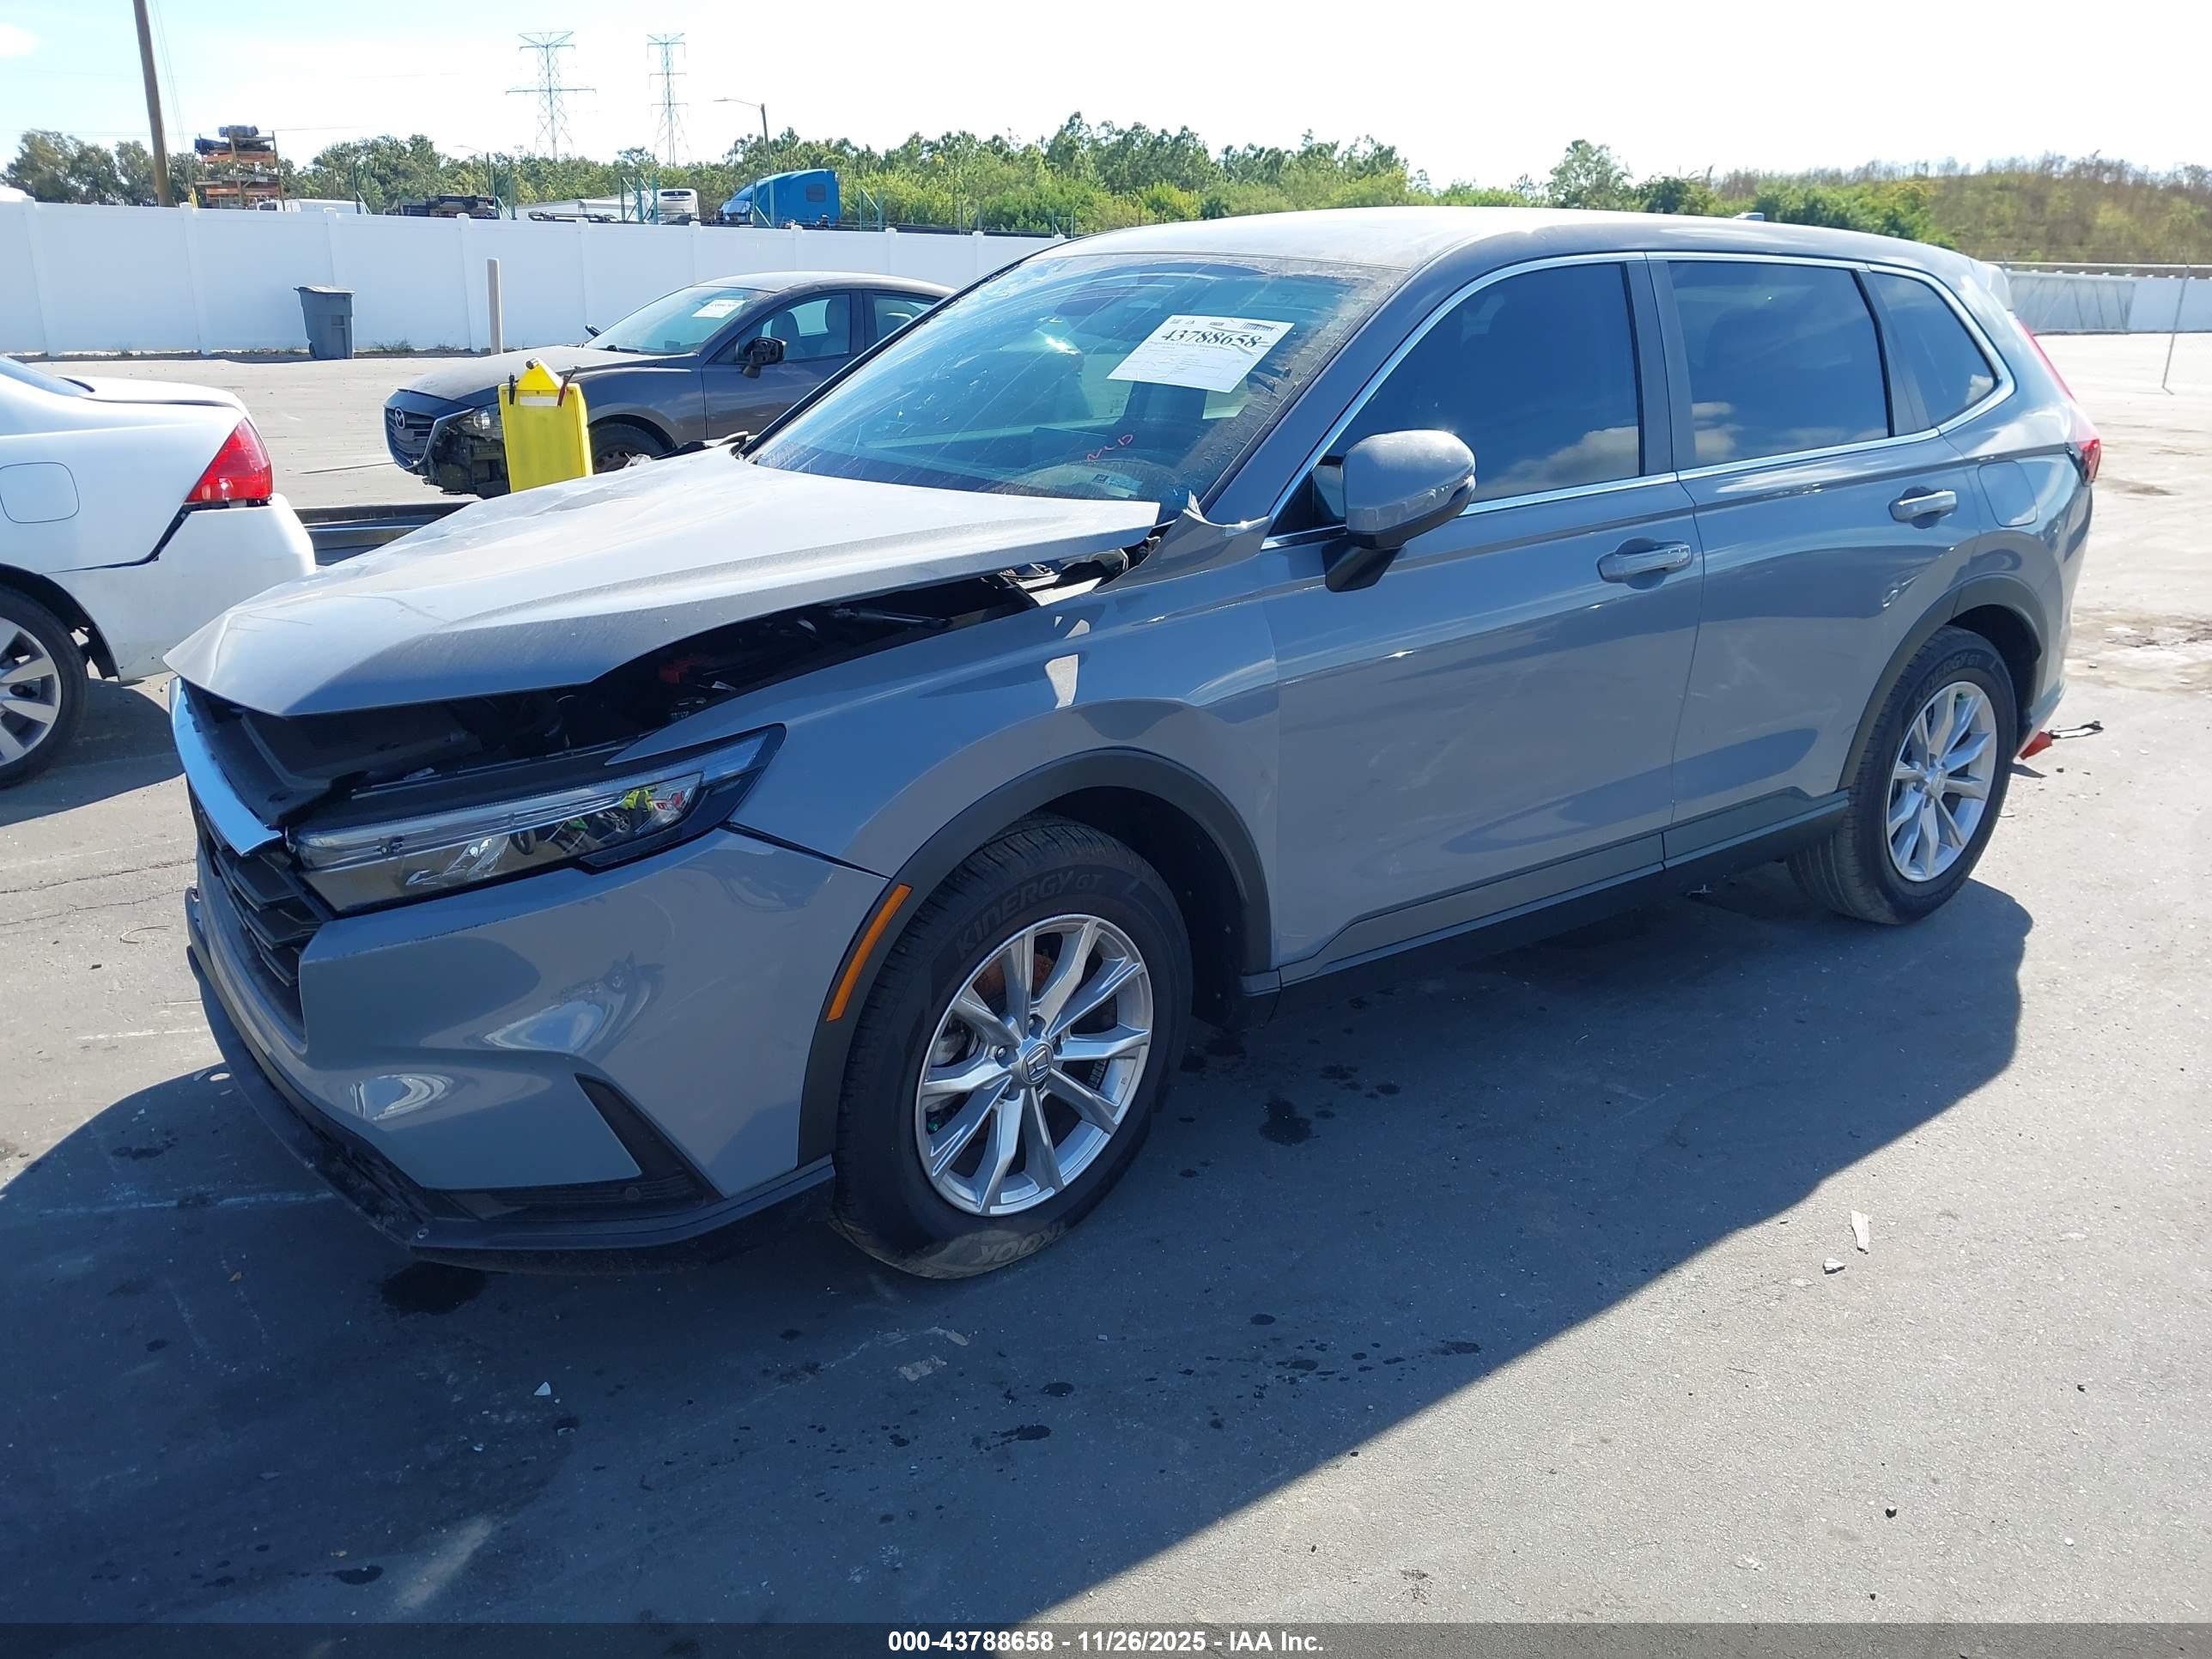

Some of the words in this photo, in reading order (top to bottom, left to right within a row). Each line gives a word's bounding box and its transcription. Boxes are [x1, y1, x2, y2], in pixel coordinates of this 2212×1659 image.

[1161, 329, 1262, 348] 43788658
[956, 870, 1074, 960] KINERGY
[1076, 872, 1104, 890] GT
